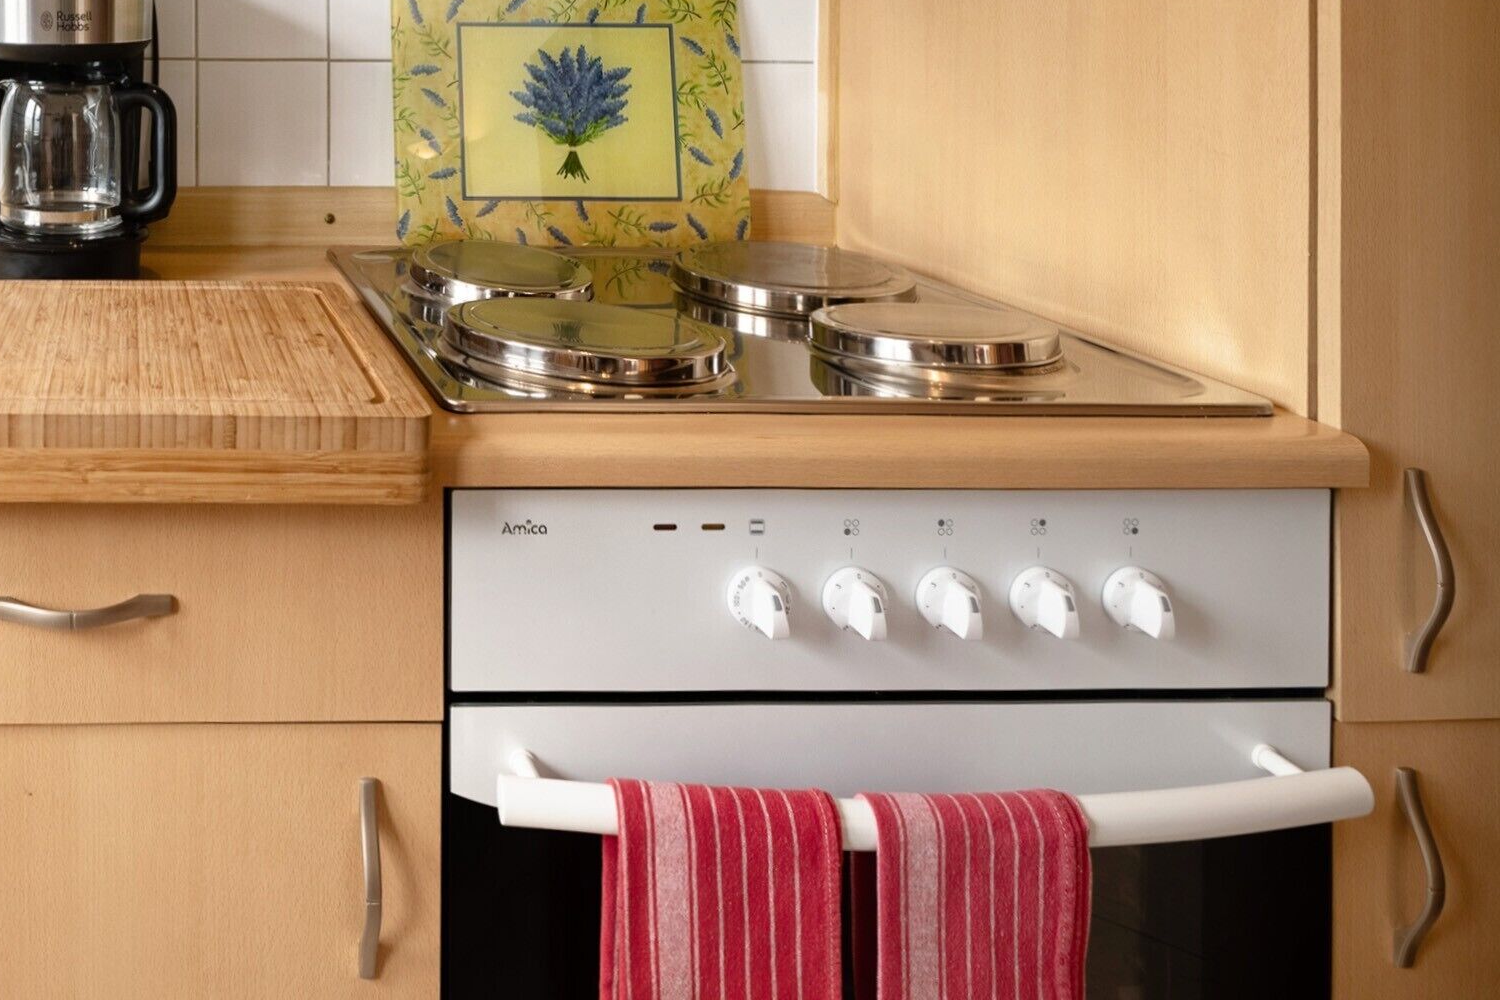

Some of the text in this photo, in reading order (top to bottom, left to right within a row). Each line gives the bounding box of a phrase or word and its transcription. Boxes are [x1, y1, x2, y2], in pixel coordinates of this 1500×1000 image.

[56, 11, 92, 21] Russell
[56, 21, 90, 31] Hobbs
[501, 519, 548, 535] Amica
